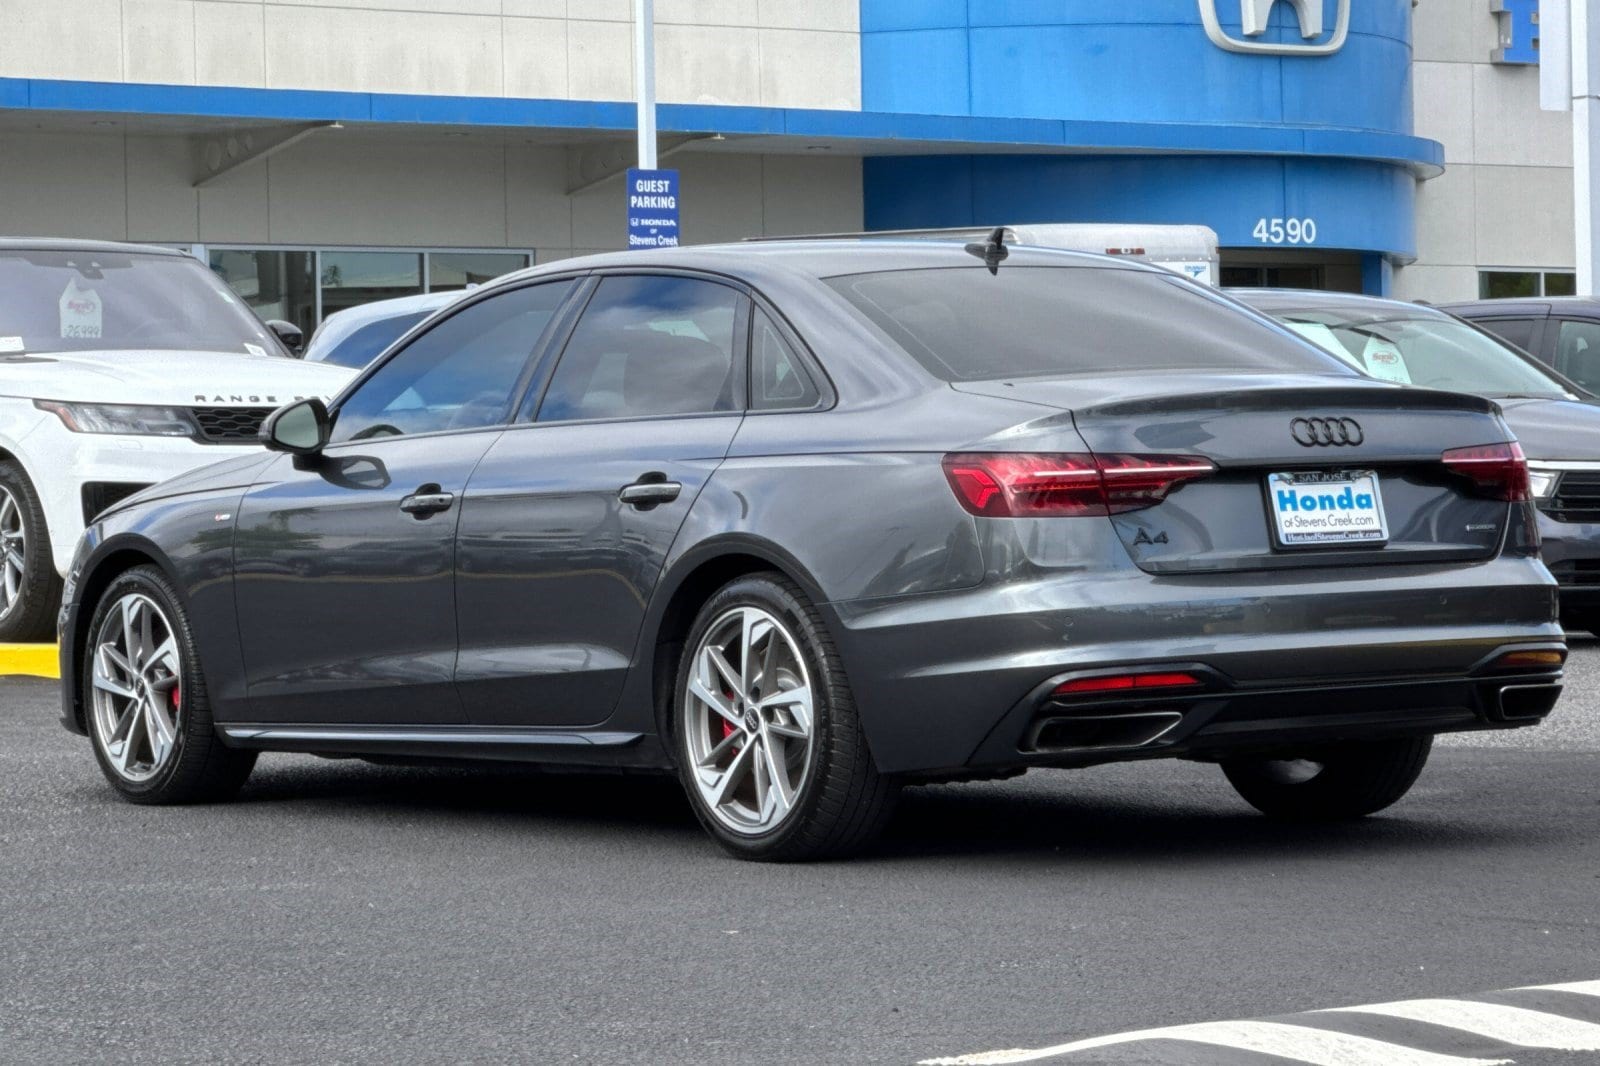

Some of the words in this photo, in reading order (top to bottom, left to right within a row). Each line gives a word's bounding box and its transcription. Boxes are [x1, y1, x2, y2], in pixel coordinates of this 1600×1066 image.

[636, 180, 670, 193] GUEST
[631, 196, 676, 209] PARKING
[641, 218, 676, 226] HONDA
[1253, 218, 1316, 244] 4590
[629, 235, 657, 246] Stevens
[658, 235, 678, 247] Creek
[194, 395, 277, 403] RANGE
[1277, 487, 1373, 512] Honda
[1133, 527, 1169, 546] A4
